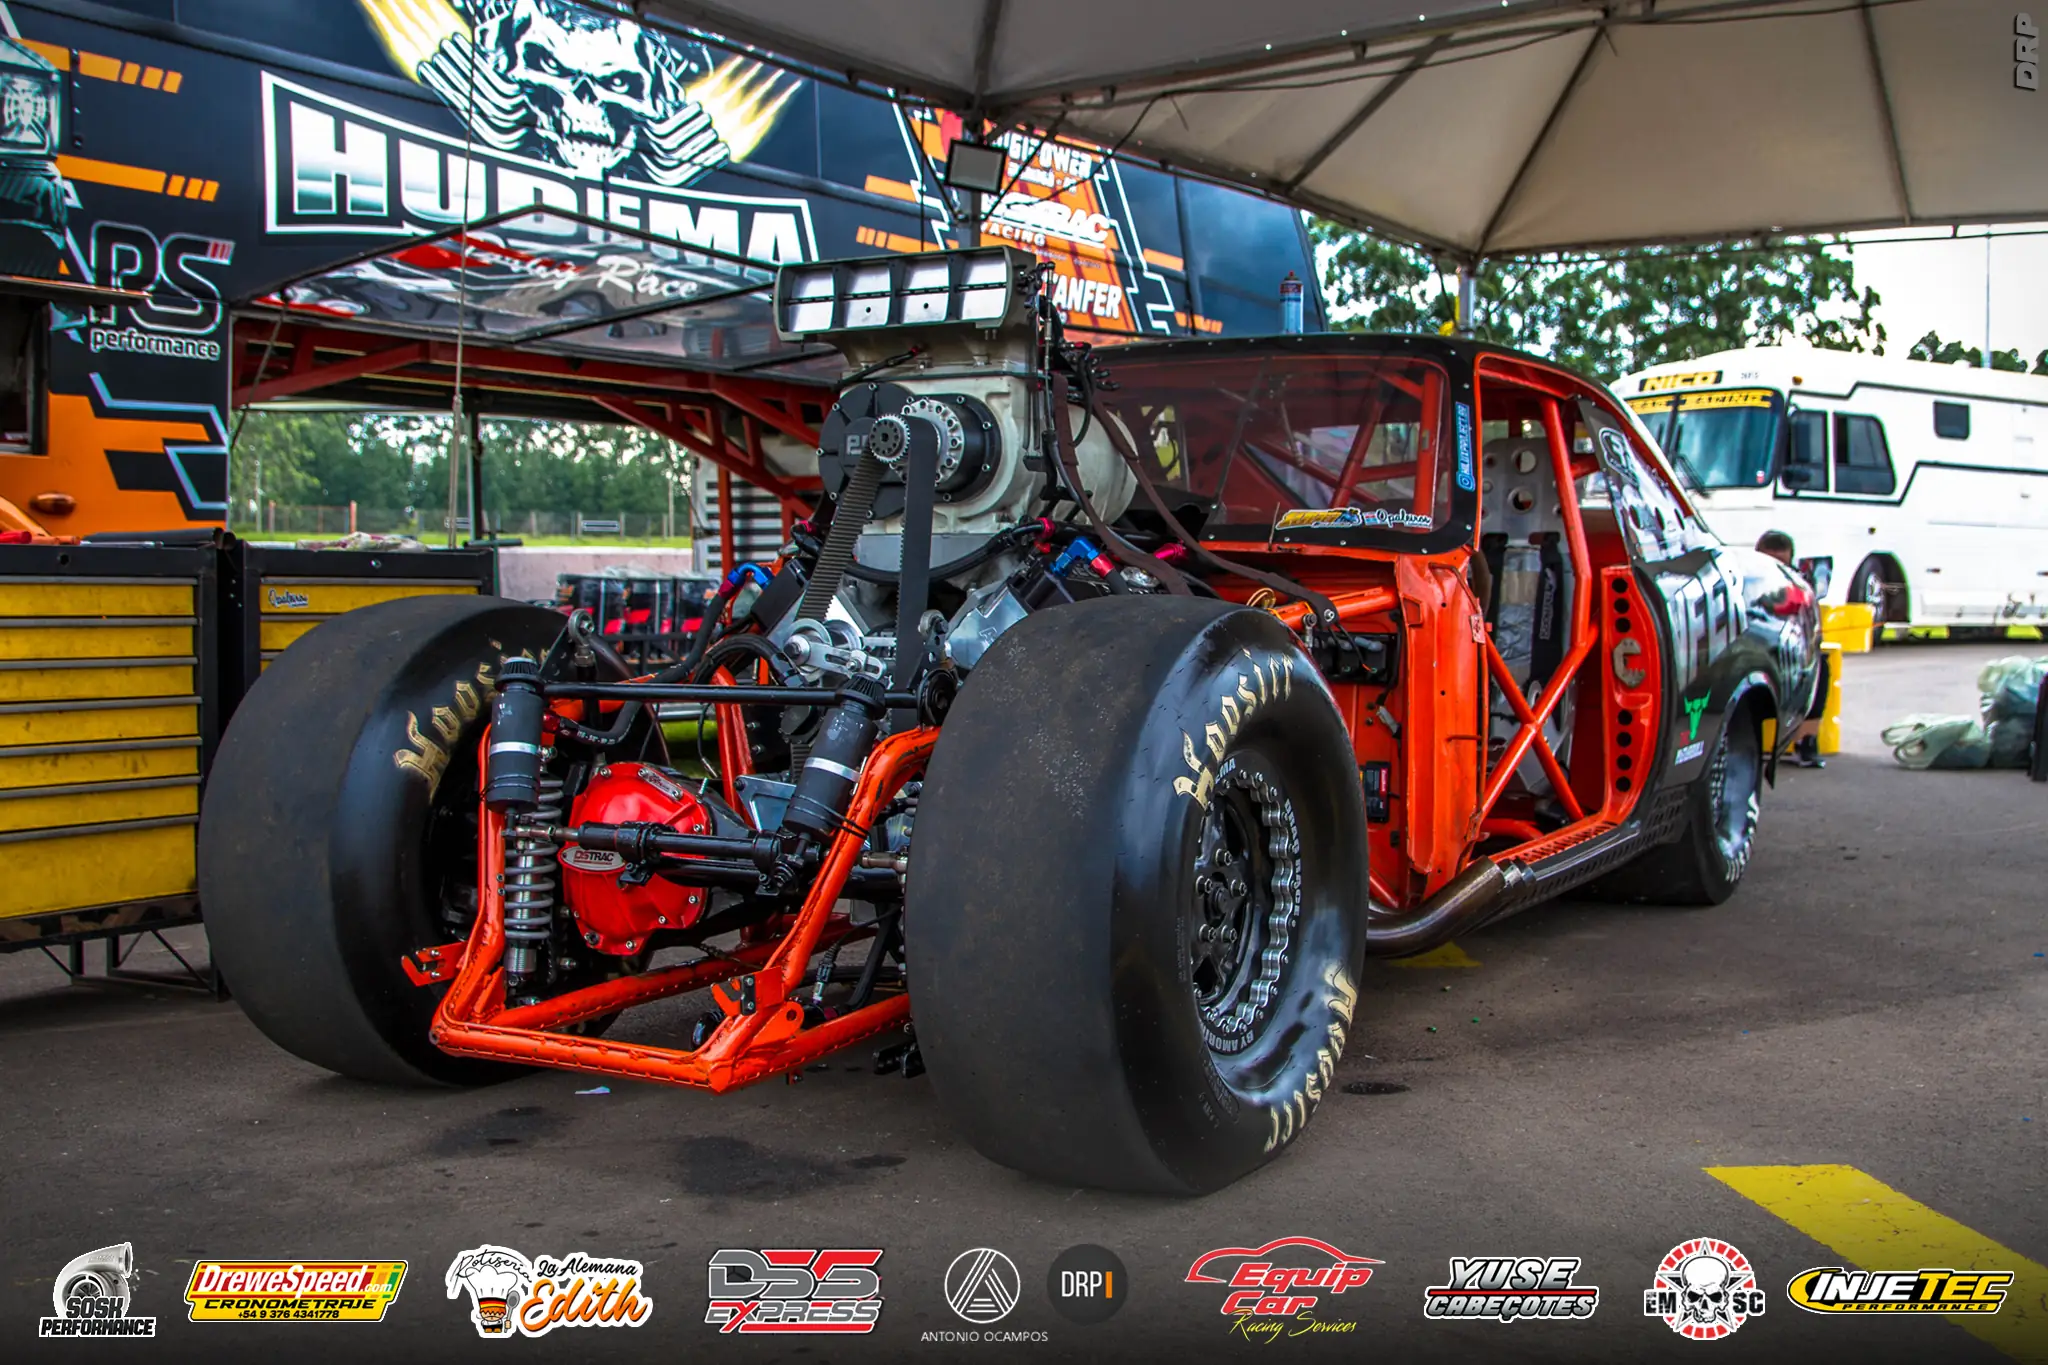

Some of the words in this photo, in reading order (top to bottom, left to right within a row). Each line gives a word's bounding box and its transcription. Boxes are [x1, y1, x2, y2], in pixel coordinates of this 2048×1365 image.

[90, 326, 222, 361] performance
[1643, 371, 1718, 391] NICO
[1240, 1028, 1255, 1049] BY
